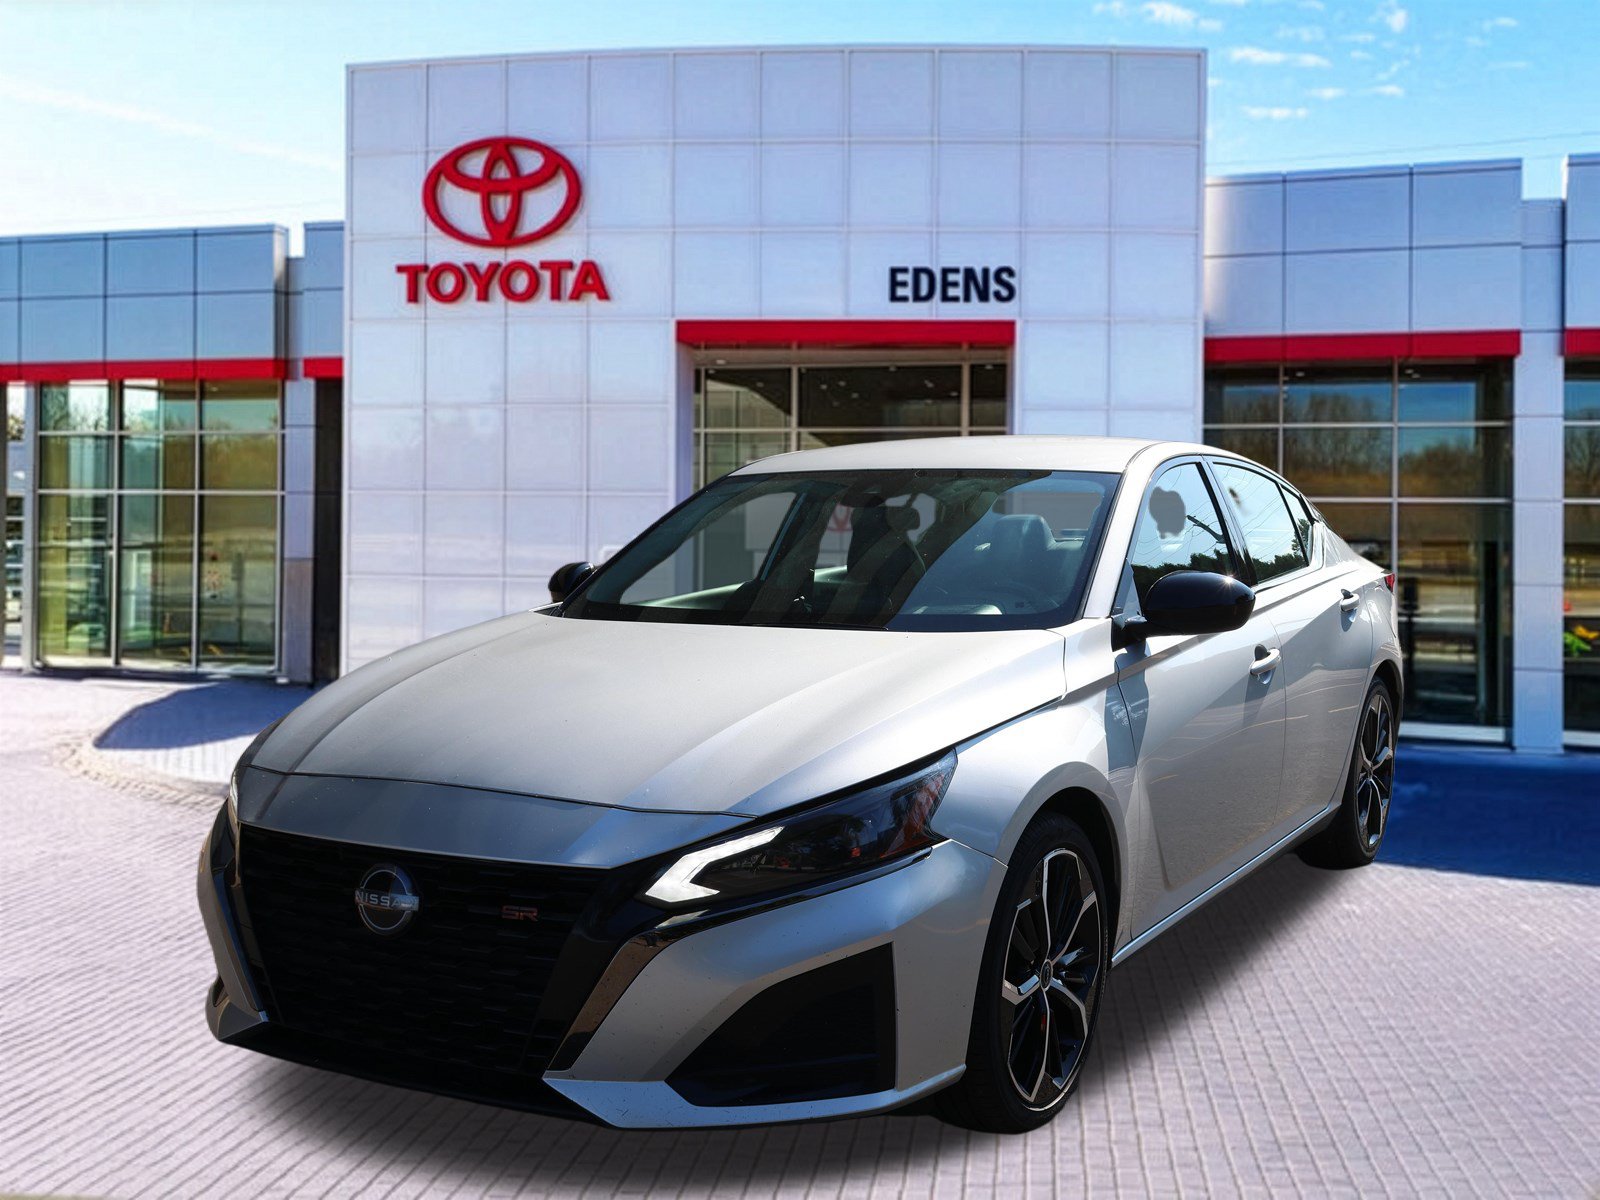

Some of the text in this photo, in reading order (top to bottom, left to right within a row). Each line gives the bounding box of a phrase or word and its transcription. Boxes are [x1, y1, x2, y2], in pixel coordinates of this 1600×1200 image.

[396, 260, 610, 303] TOYOTA
[889, 266, 1016, 302] EDENS
[501, 905, 538, 921] SR
